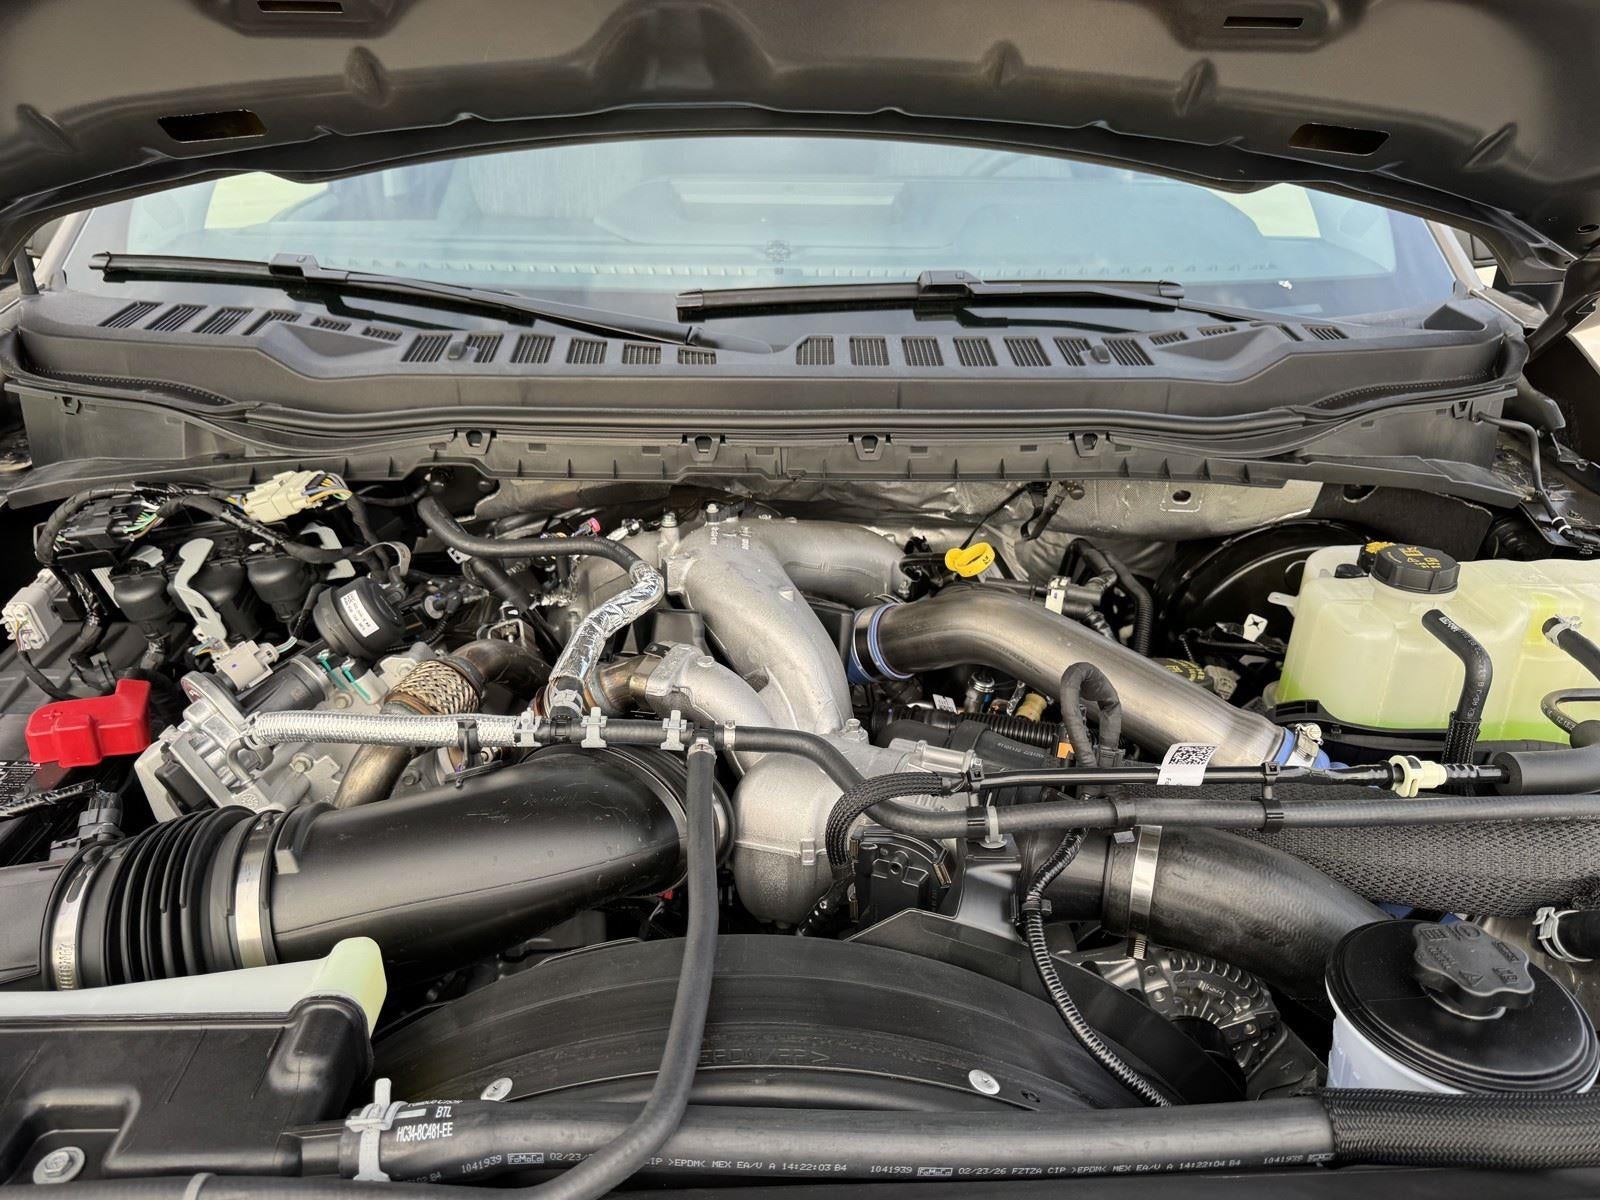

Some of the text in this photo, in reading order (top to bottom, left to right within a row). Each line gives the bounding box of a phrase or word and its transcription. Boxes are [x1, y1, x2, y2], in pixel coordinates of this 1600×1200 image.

[435, 1106, 452, 1119] BTL
[461, 1154, 502, 1174] 1041939
[712, 1160, 731, 1169] MEX
[769, 1162, 776, 1170] A
[782, 1162, 831, 1172] 14:22:03
[834, 1164, 847, 1172] B4
[870, 1165, 913, 1174] 1041939
[958, 1167, 1007, 1175] 02/23/26
[1112, 1164, 1132, 1172] MEX
[1166, 1162, 1174, 1170] A
[1179, 1160, 1226, 1169] 14:22:04
